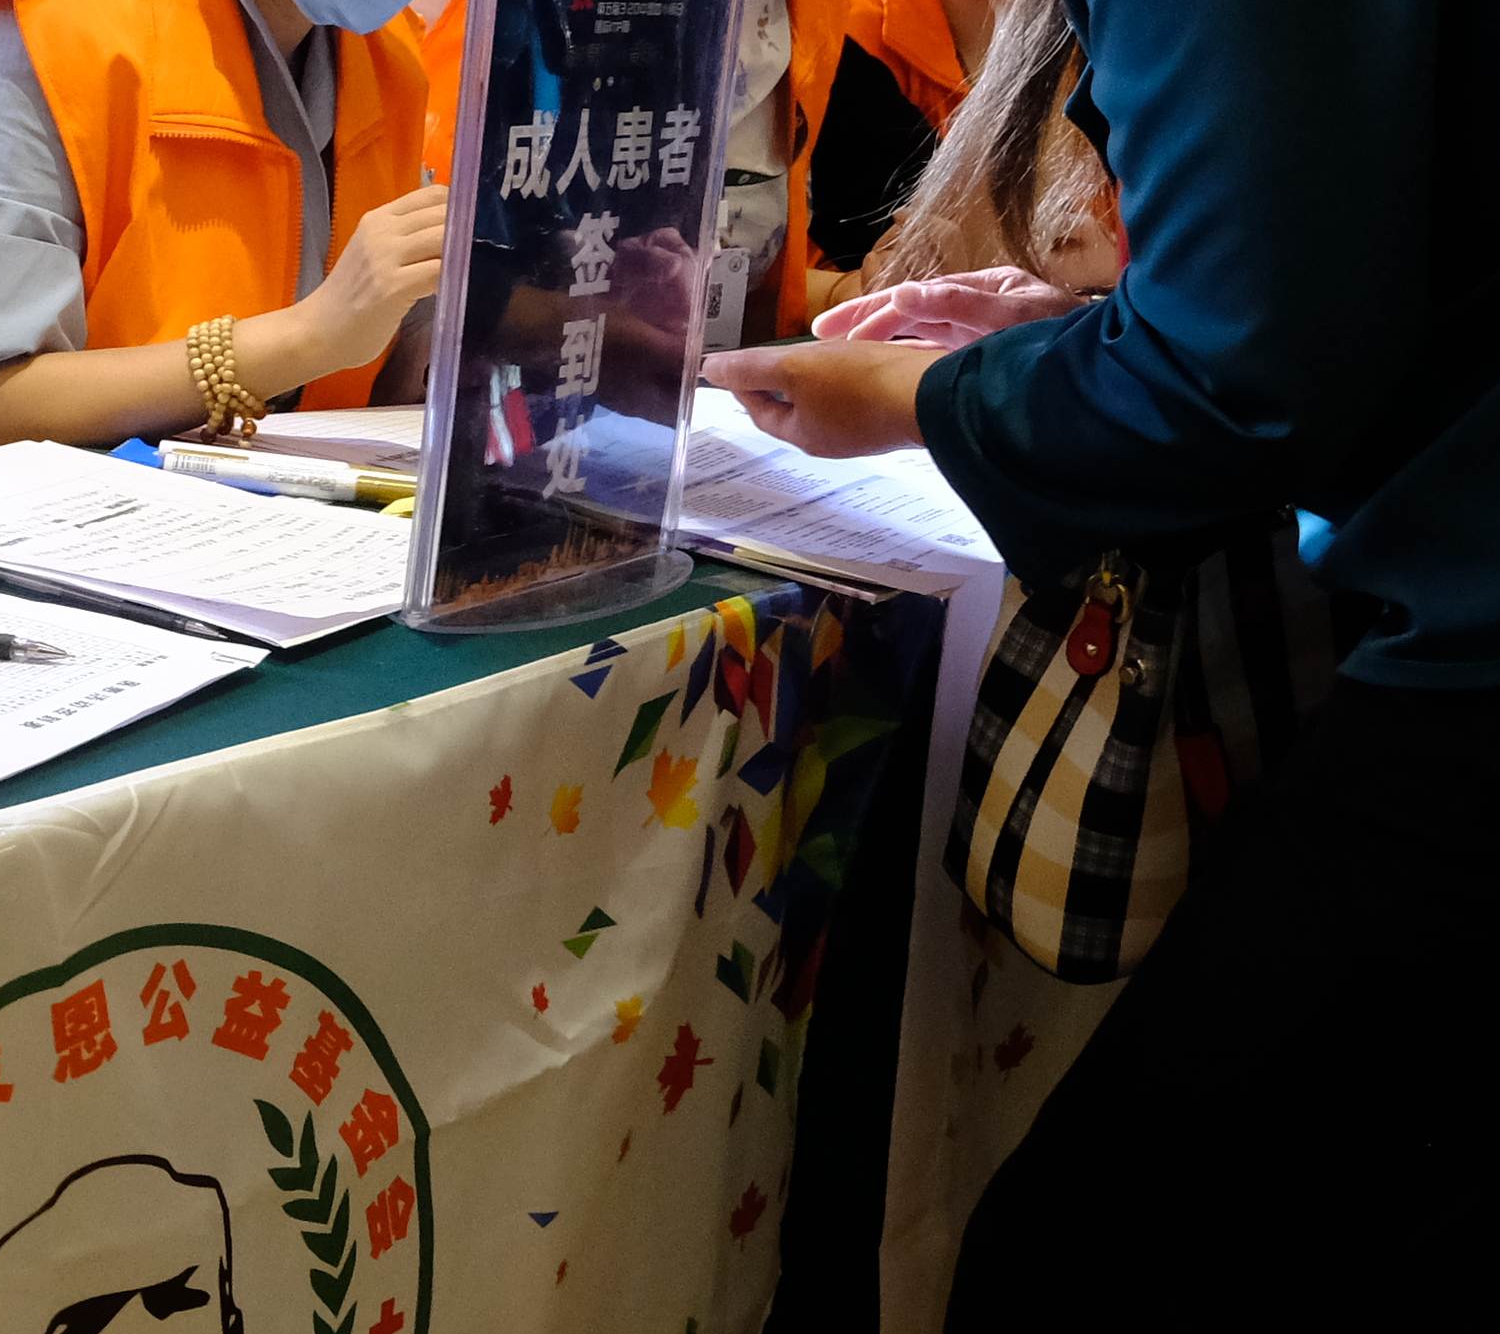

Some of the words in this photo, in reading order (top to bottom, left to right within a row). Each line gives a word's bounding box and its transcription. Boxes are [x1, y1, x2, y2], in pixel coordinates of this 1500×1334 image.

[500, 103, 701, 200] 成人患者
[542, 211, 619, 500] 签到处
